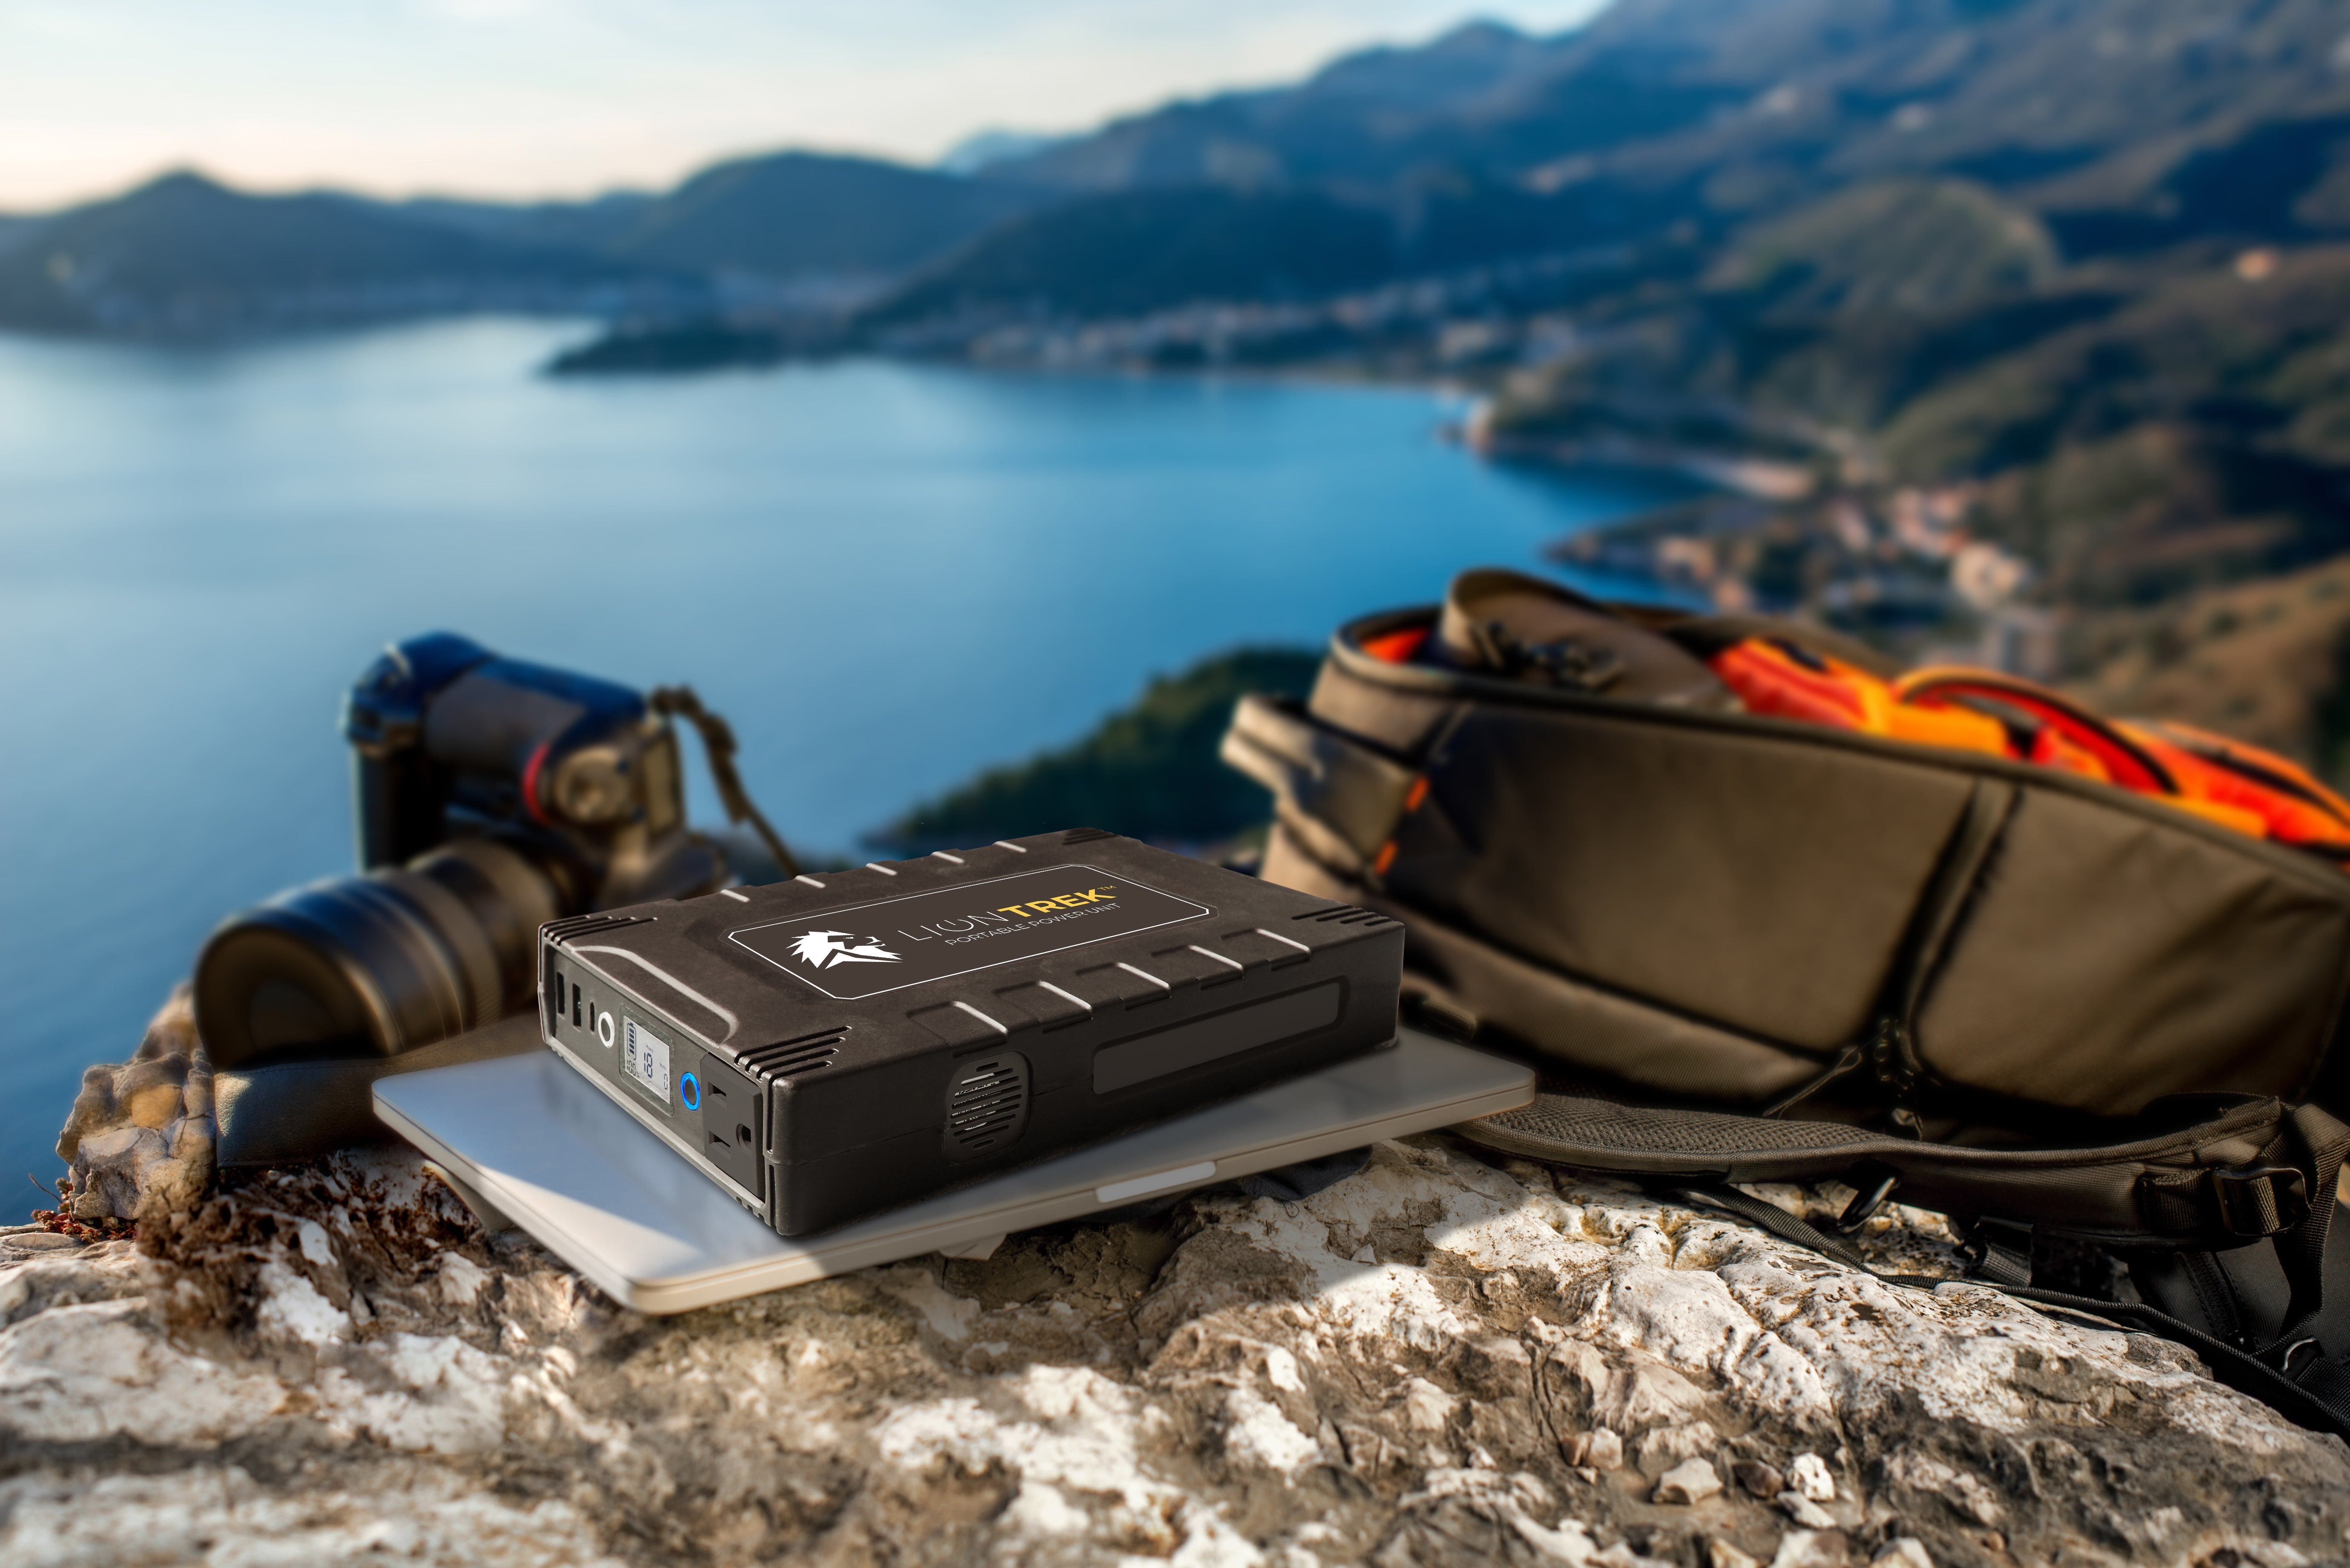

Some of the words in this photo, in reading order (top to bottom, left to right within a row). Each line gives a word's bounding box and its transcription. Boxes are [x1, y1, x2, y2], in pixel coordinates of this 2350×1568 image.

[945, 924, 1030, 945] PORTABLE
[1028, 911, 1088, 927] POWER
[1084, 903, 1121, 913] UNIT
[644, 1052, 653, 1079] 18
[664, 1073, 668, 1090] 0
